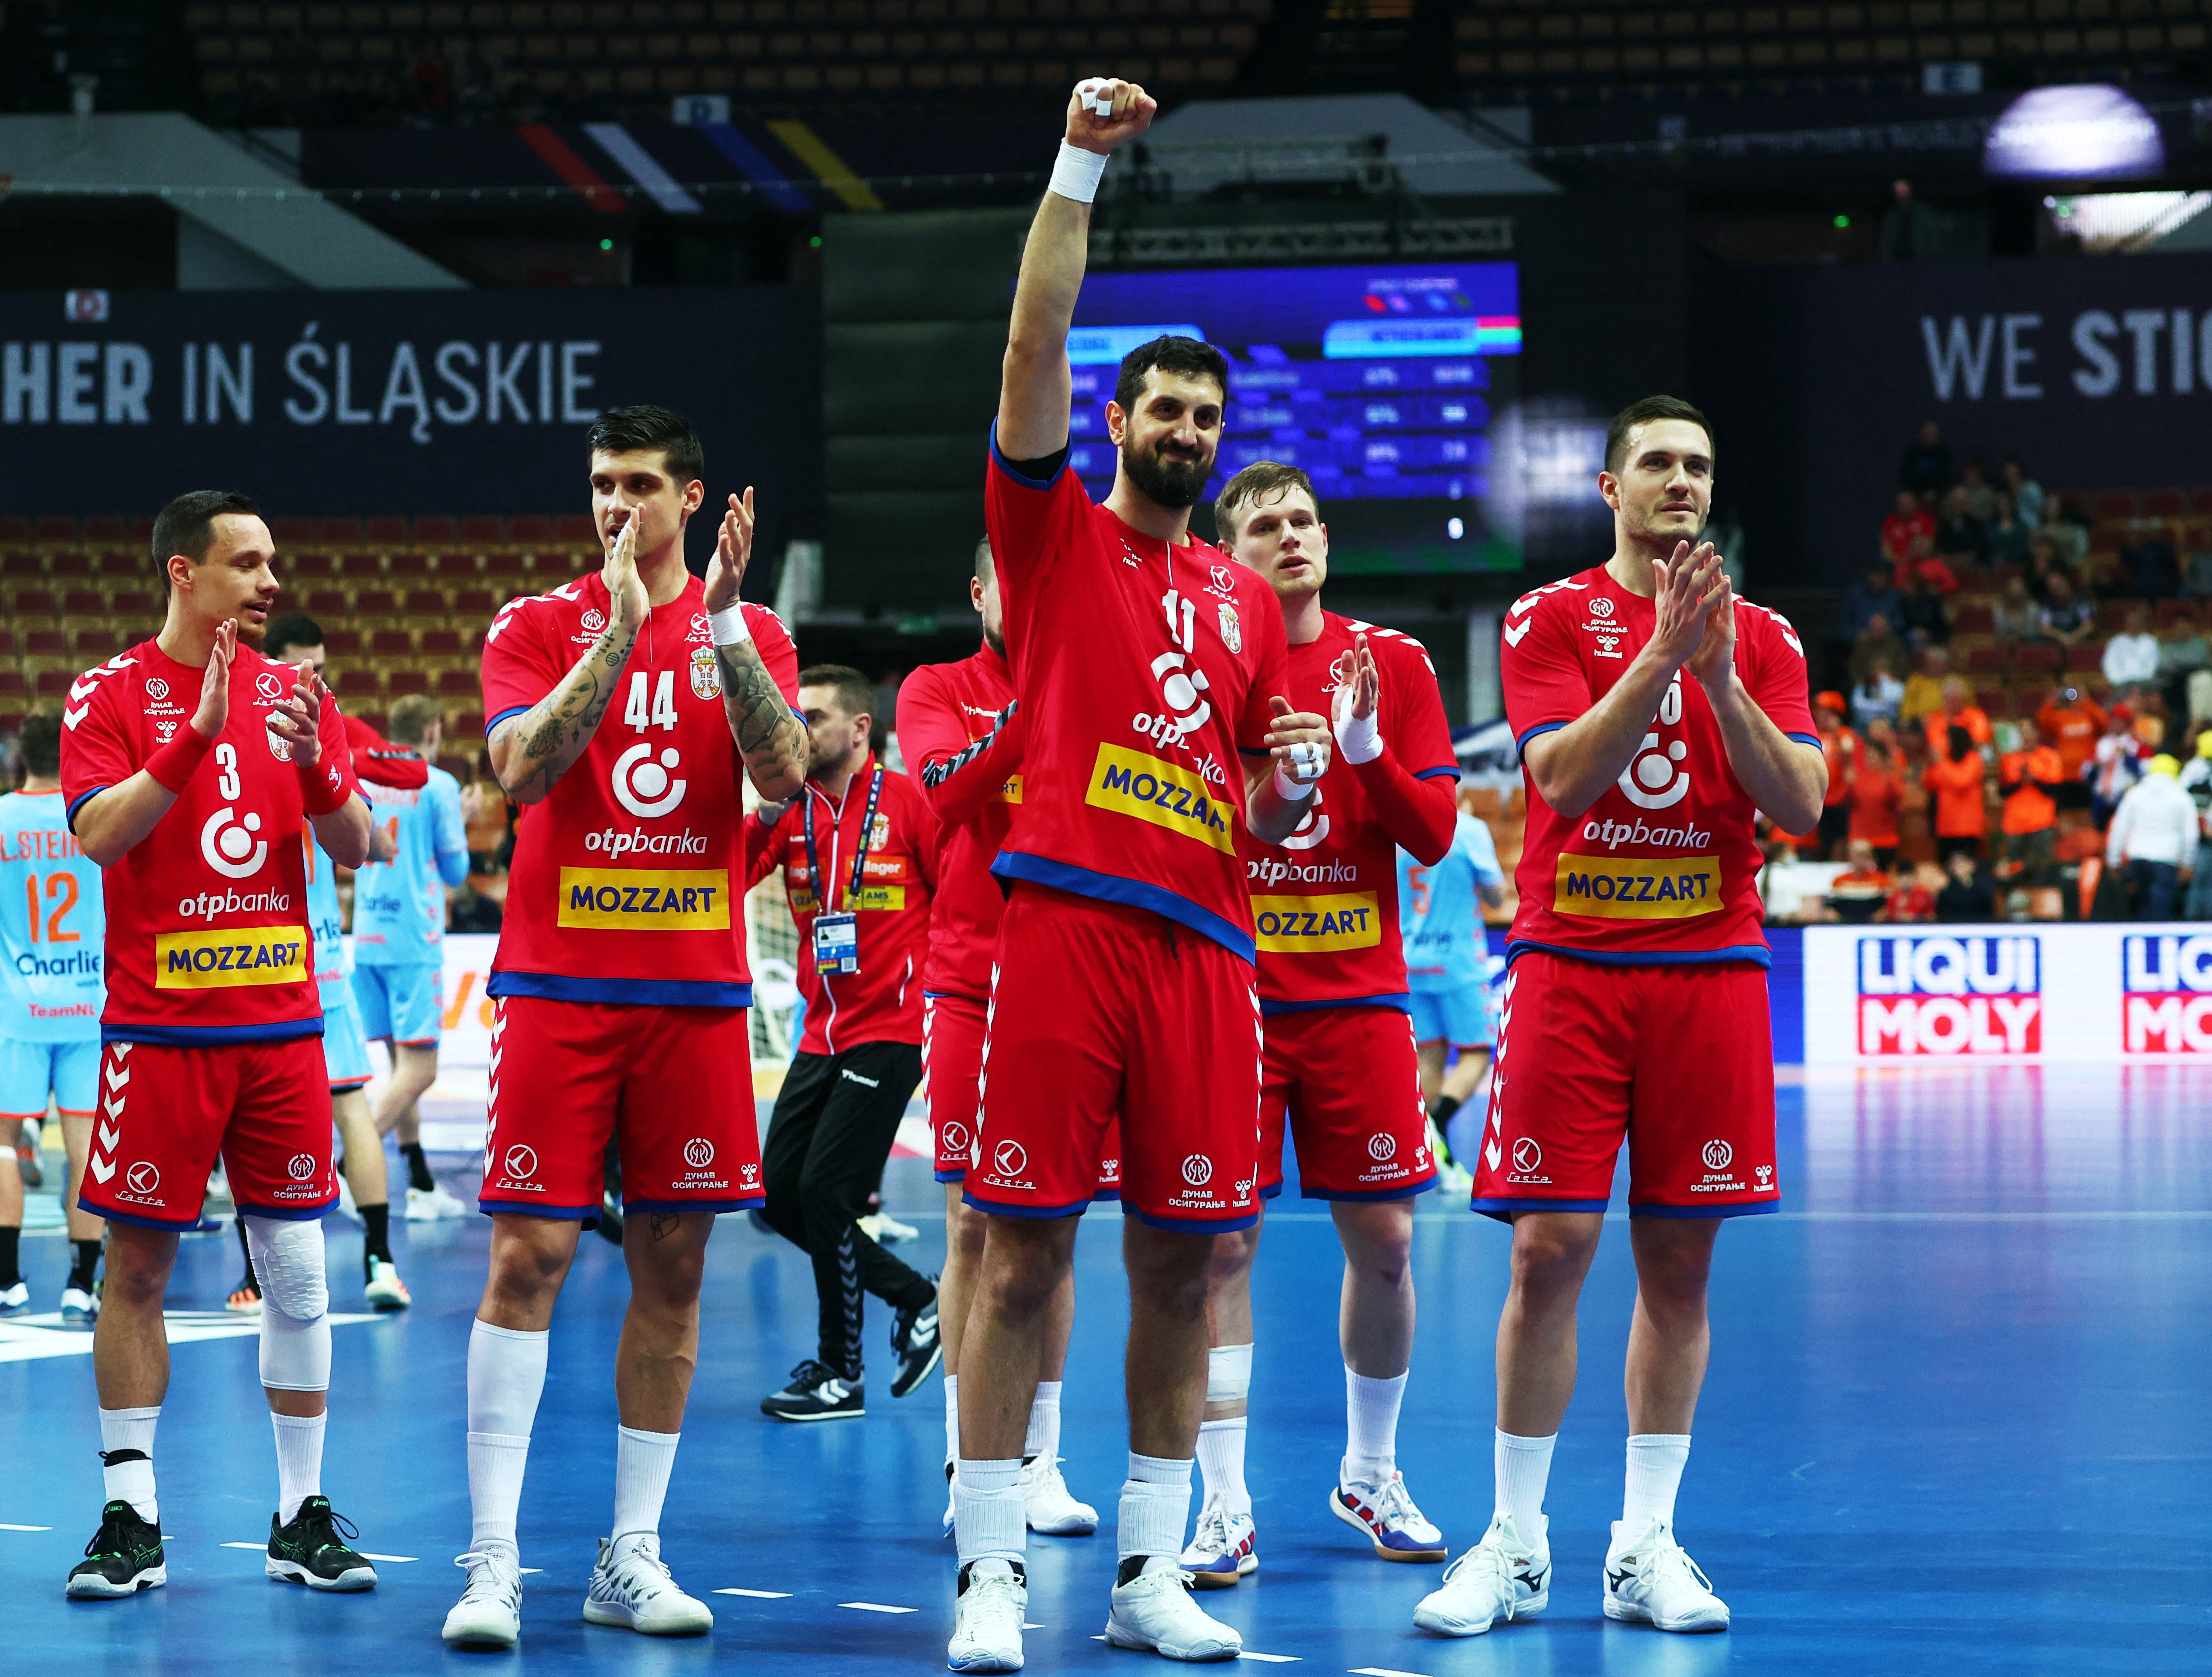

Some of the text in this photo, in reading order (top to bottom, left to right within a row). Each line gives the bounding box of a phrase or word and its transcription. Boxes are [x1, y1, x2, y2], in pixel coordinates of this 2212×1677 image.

[1920, 314, 2045, 400] WE
[3, 321, 601, 444] HER IN ŚLĄSKIE
[1123, 556, 1139, 569] hum
[1162, 589, 1195, 653] 11
[1582, 623, 1628, 633] ОСИГУРАЊЕ
[571, 636, 599, 644] ОСИГУ
[684, 632, 714, 642] Last
[1594, 649, 1623, 659] hummel
[252, 697, 293, 706] Lasa
[624, 670, 678, 734] 44
[1652, 668, 1682, 725] 6
[216, 743, 240, 800] 3
[1102, 764, 1225, 833] MOZZA
[1584, 817, 1711, 850] otpbanka
[585, 827, 708, 860] otpbanka
[1247, 857, 1357, 887] otpbanka
[1409, 866, 1431, 915] 5
[1567, 873, 1711, 900] MOZZART
[179, 887, 290, 921] otpbanka
[570, 886, 717, 913] MOZZART
[26, 872, 81, 943] 12
[1255, 908, 1370, 936] OZZART
[169, 942, 300, 973] MOZZART
[1862, 938, 2037, 995] LIQUI
[29, 1003, 96, 1018] TeamNL
[1862, 998, 2040, 1054] MOLY
[939, 1152, 968, 1161] Last
[1358, 1169, 1410, 1181] ОСИГУРАЊЕ
[1370, 1162, 1398, 1173] ДУНАВ
[684, 1172, 716, 1181] ДУНАВ
[983, 1174, 1036, 1189] Lasta
[1506, 1172, 1552, 1184] Lasta
[1703, 1174, 1733, 1183] ДУНАВ
[496, 1178, 546, 1192] Lasta
[672, 1180, 729, 1190] ОСИГУРАЊЕ
[740, 1181, 760, 1191] hummel
[1690, 1182, 1746, 1193] ОСИГУРАЊЕ
[1753, 1182, 1774, 1192] hummel
[115, 1191, 166, 1206] Lasta
[273, 1191, 321, 1199] ОСИГУРАЊЕ
[1182, 1190, 1213, 1199] ДУНАВ
[1168, 1198, 1226, 1209] ОСИГУРАЊЕ
